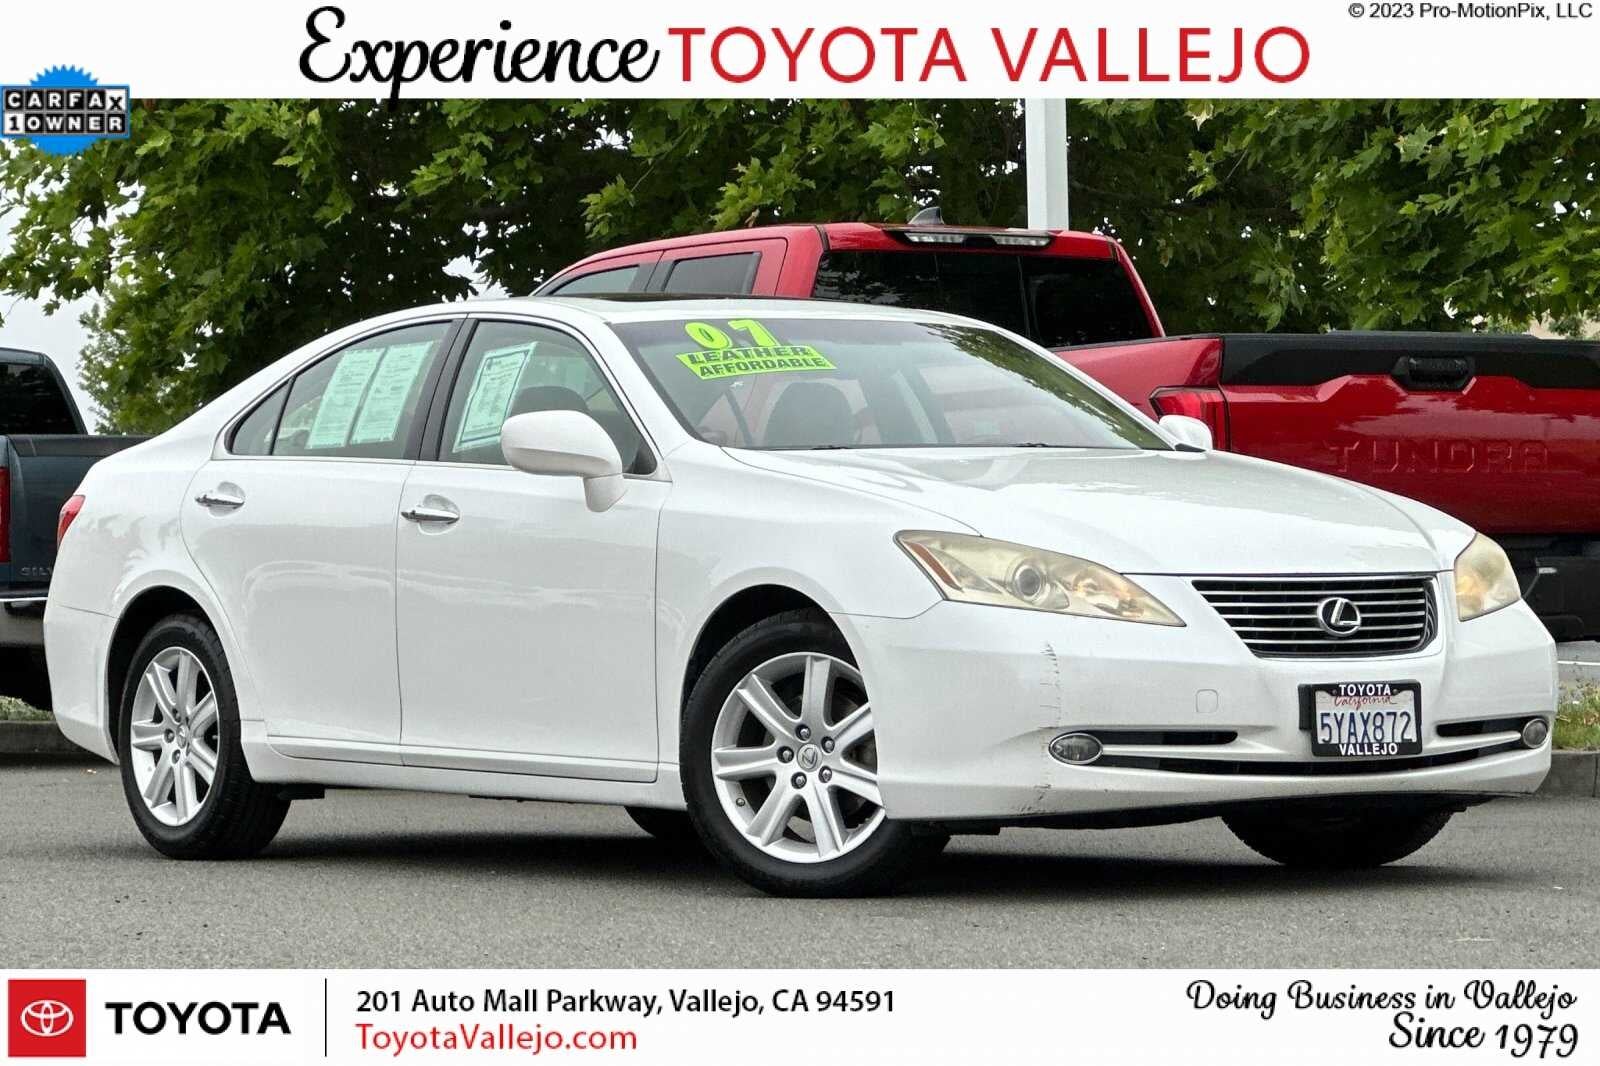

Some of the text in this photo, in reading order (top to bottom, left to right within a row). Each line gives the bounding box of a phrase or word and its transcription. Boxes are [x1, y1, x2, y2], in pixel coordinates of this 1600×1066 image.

[684, 318, 781, 350] 07
[686, 345, 814, 365] LEATHER
[699, 356, 828, 378] AFFORDABLE
[1323, 439, 1549, 473] TUNDRA
[1338, 683, 1392, 696] TOYOTA
[1334, 694, 1397, 710] California
[1319, 711, 1413, 744] 5YAX872
[1338, 742, 1399, 756] VALLEJO
